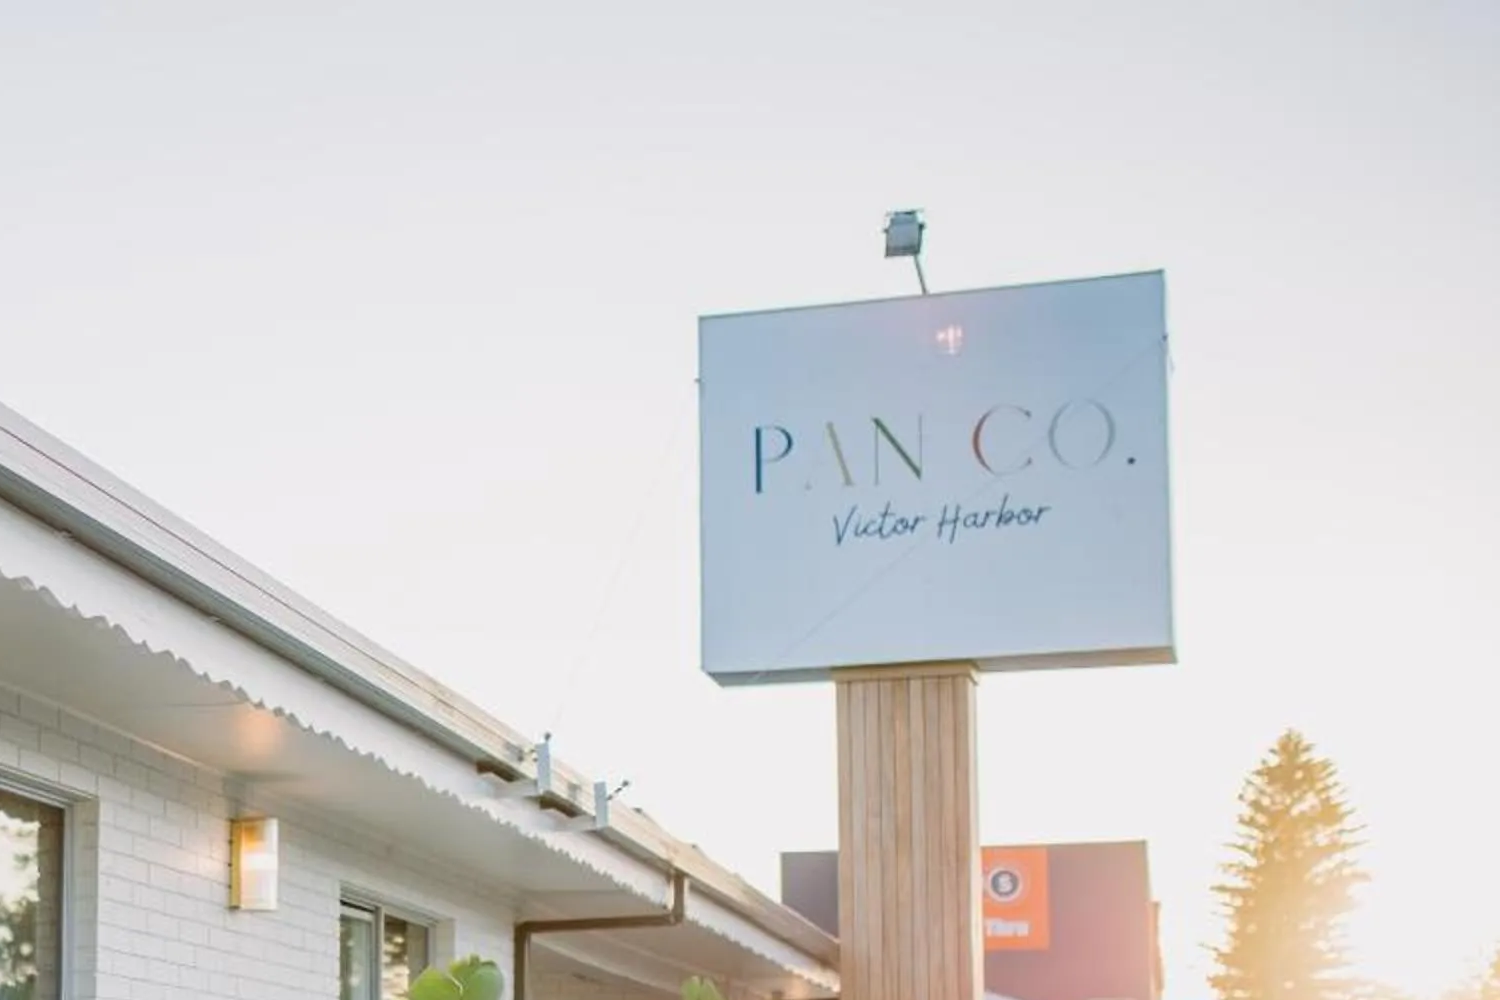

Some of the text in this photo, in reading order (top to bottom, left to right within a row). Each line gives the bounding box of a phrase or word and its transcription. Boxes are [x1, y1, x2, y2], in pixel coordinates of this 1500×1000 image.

[755, 399, 1136, 494] PAN CO.
[833, 493, 1052, 546] Victor Harbor
